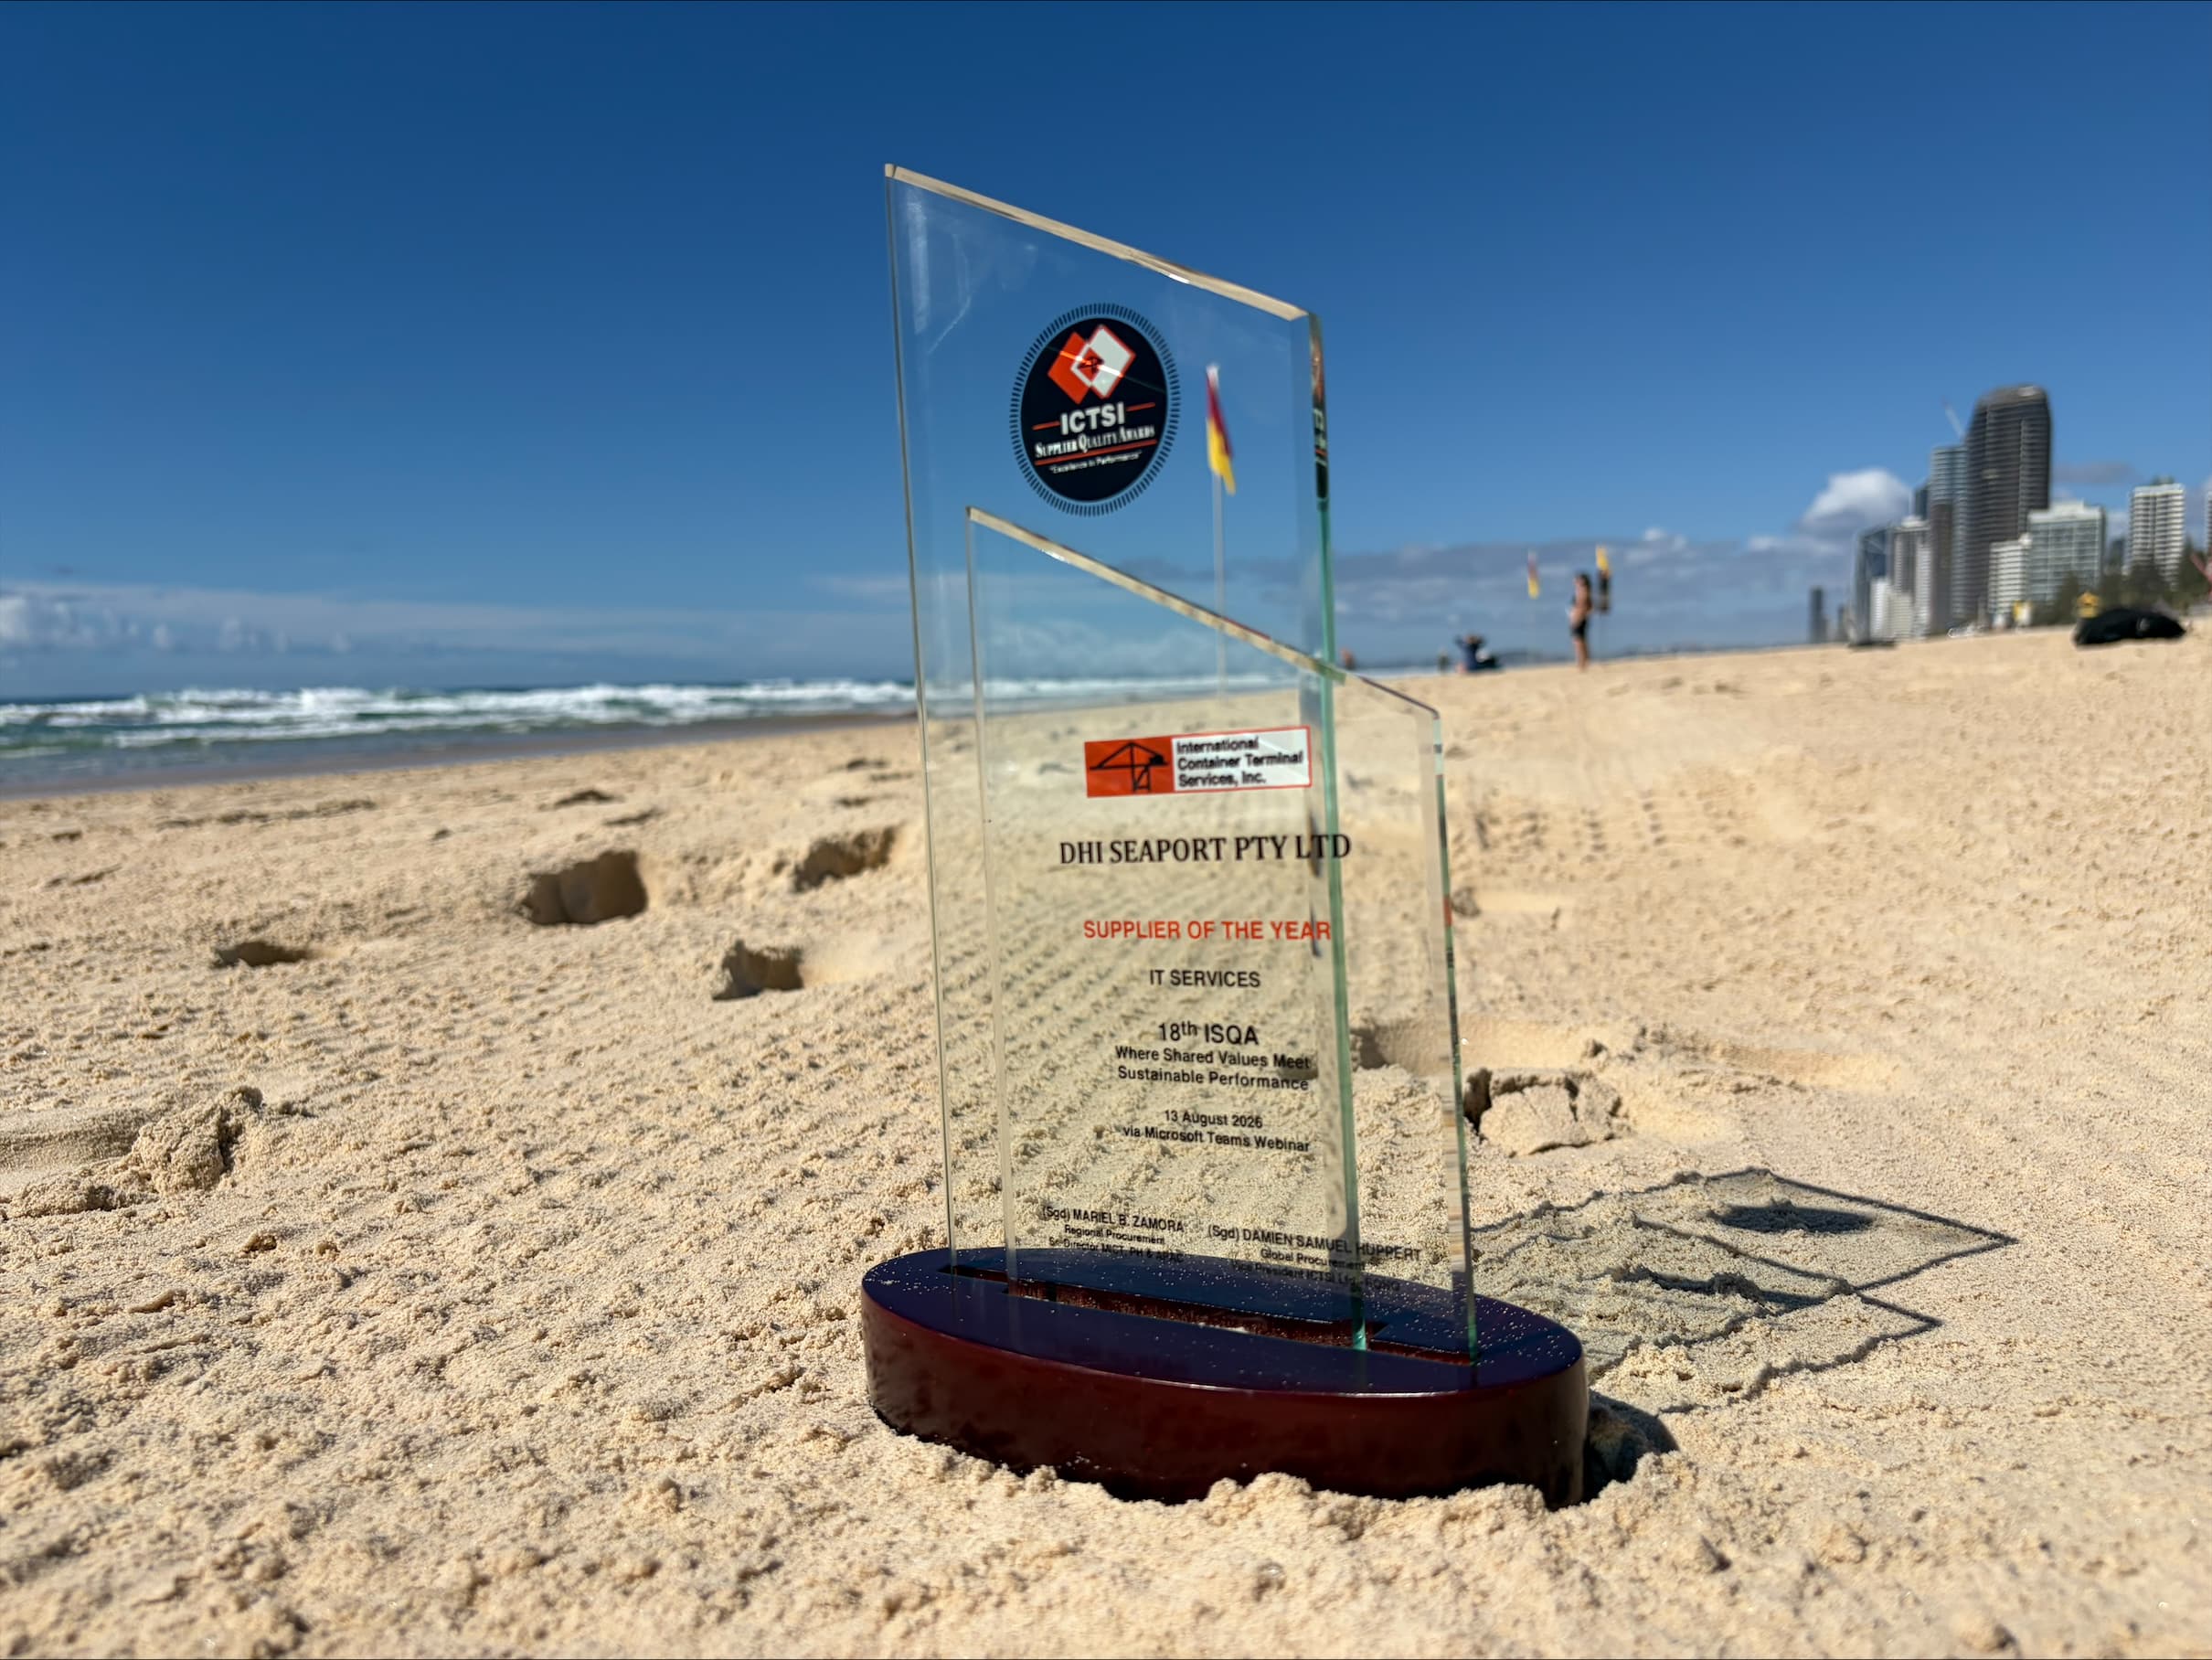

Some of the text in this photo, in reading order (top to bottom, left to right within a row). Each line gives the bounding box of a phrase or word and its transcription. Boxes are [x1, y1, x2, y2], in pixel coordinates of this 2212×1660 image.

[1061, 401, 1125, 435] ICTSI
[1177, 736, 1259, 754] International
[1177, 750, 1303, 771] Container Terminal
[1179, 771, 1266, 787] Services, Inc.
[1060, 834, 1351, 864] DHI SEAPORT PTY LTD
[1083, 920, 1331, 940] SUPPLIER OF THE YEAR
[1150, 969, 1261, 988] IT SERVICES
[1159, 1021, 1259, 1045] 18th ISQA
[1115, 1046, 1310, 1069] Where Shared Values Meet
[1118, 1067, 1309, 1091] Sustainable Performance
[1165, 1110, 1263, 1129] 13 August 2026
[1123, 1126, 1310, 1152] via Microsoft Teams Webinar
[1043, 1206, 1185, 1233] (Sgd) MARIEL B. ZAMORA
[1064, 1224, 1165, 1245] Regional Procurement
[1208, 1225, 1421, 1261] (Sgd) DAMIEN SAMUEL HUPPERT
[1260, 1248, 1366, 1270] Global Procurement
